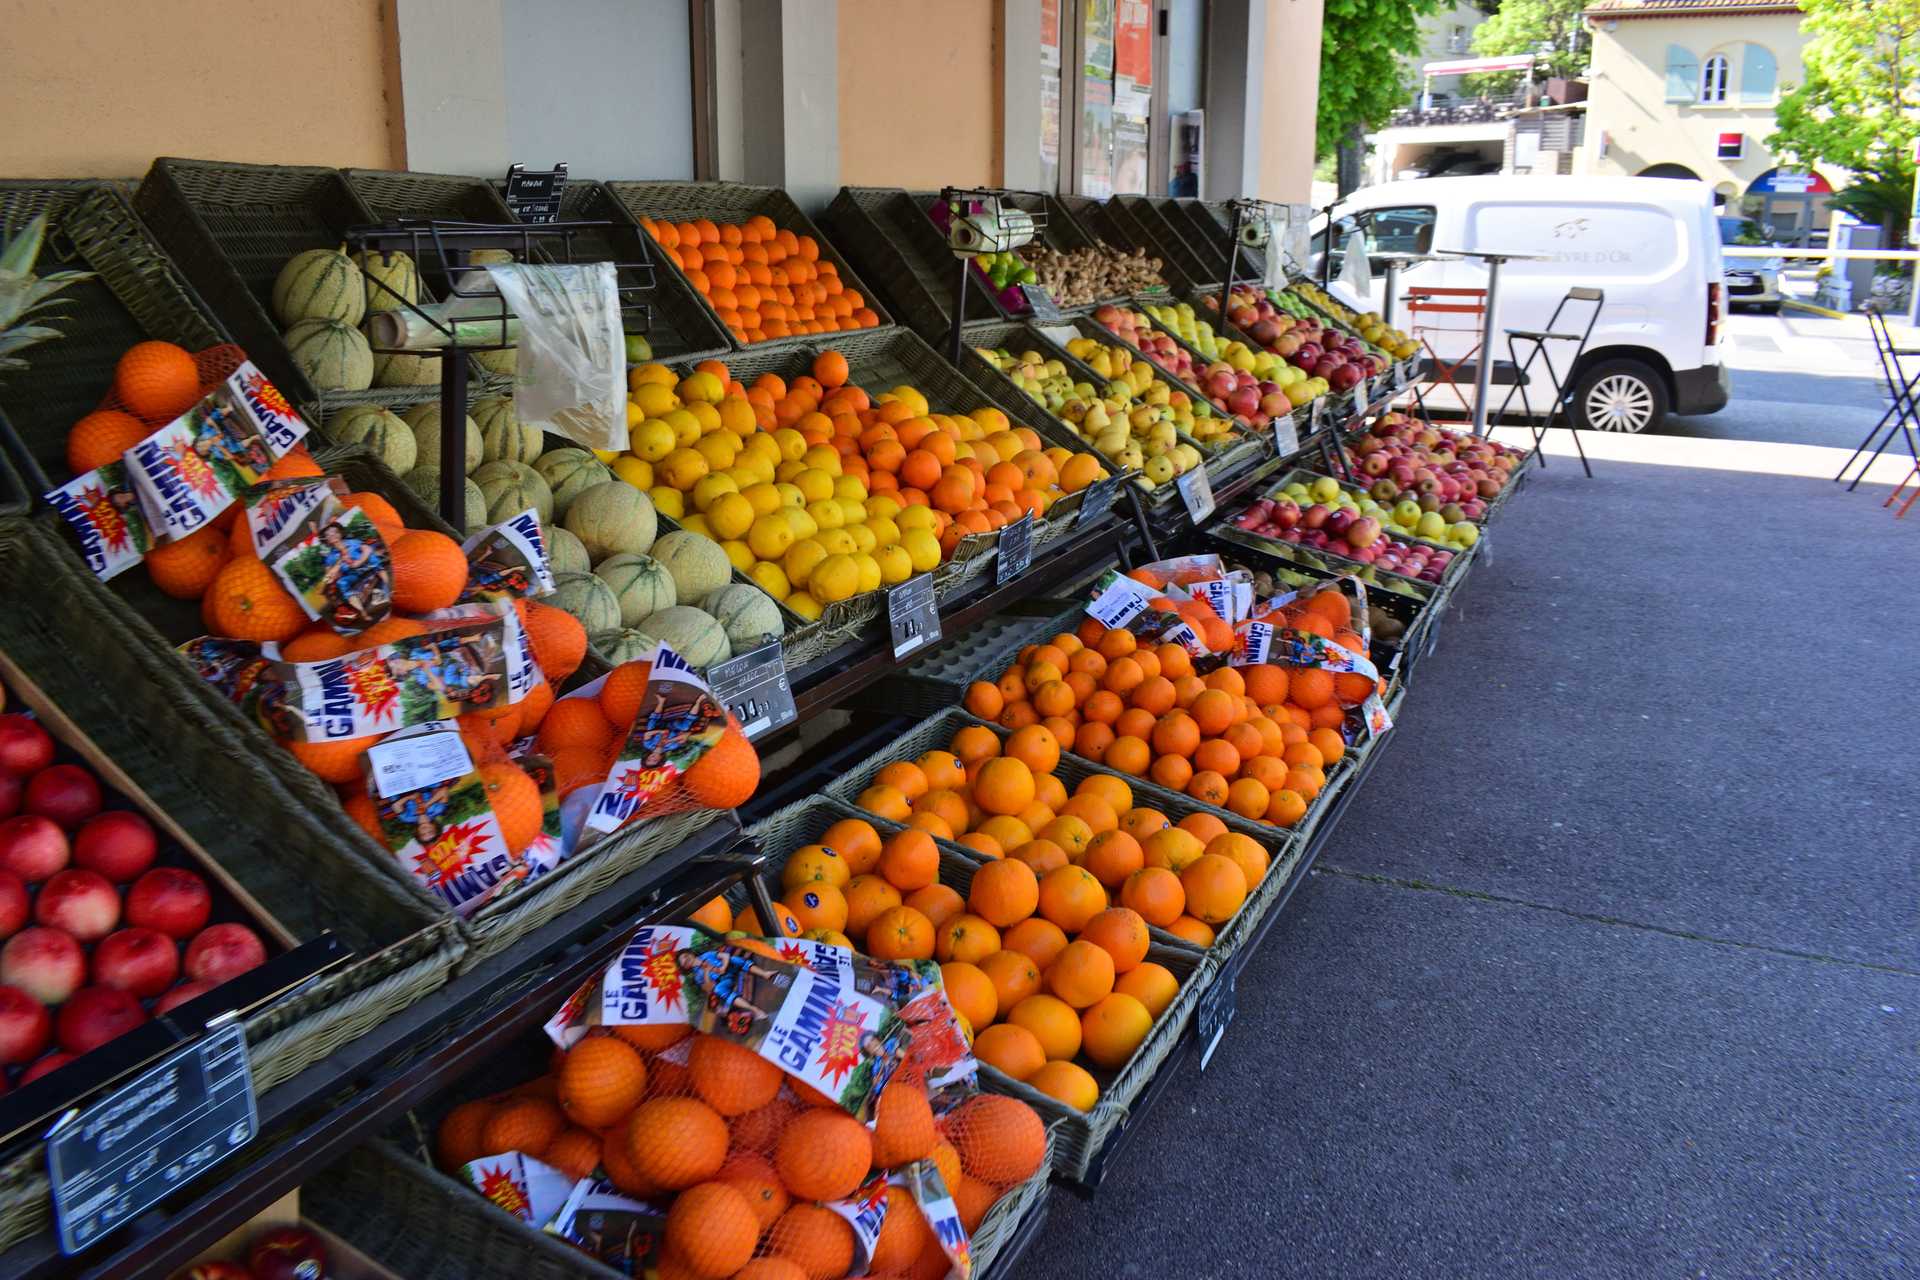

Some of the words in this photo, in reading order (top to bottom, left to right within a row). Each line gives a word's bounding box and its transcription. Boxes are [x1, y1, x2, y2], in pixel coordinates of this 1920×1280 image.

[136, 440, 207, 531] GAMIN
[1246, 622, 1265, 664] GAMIN
[315, 659, 356, 739] GAMIN
[604, 989, 619, 1008] LE
[620, 928, 656, 1020] GAMIN
[770, 1024, 789, 1046] LE
[779, 975, 842, 1072] GAMIN
